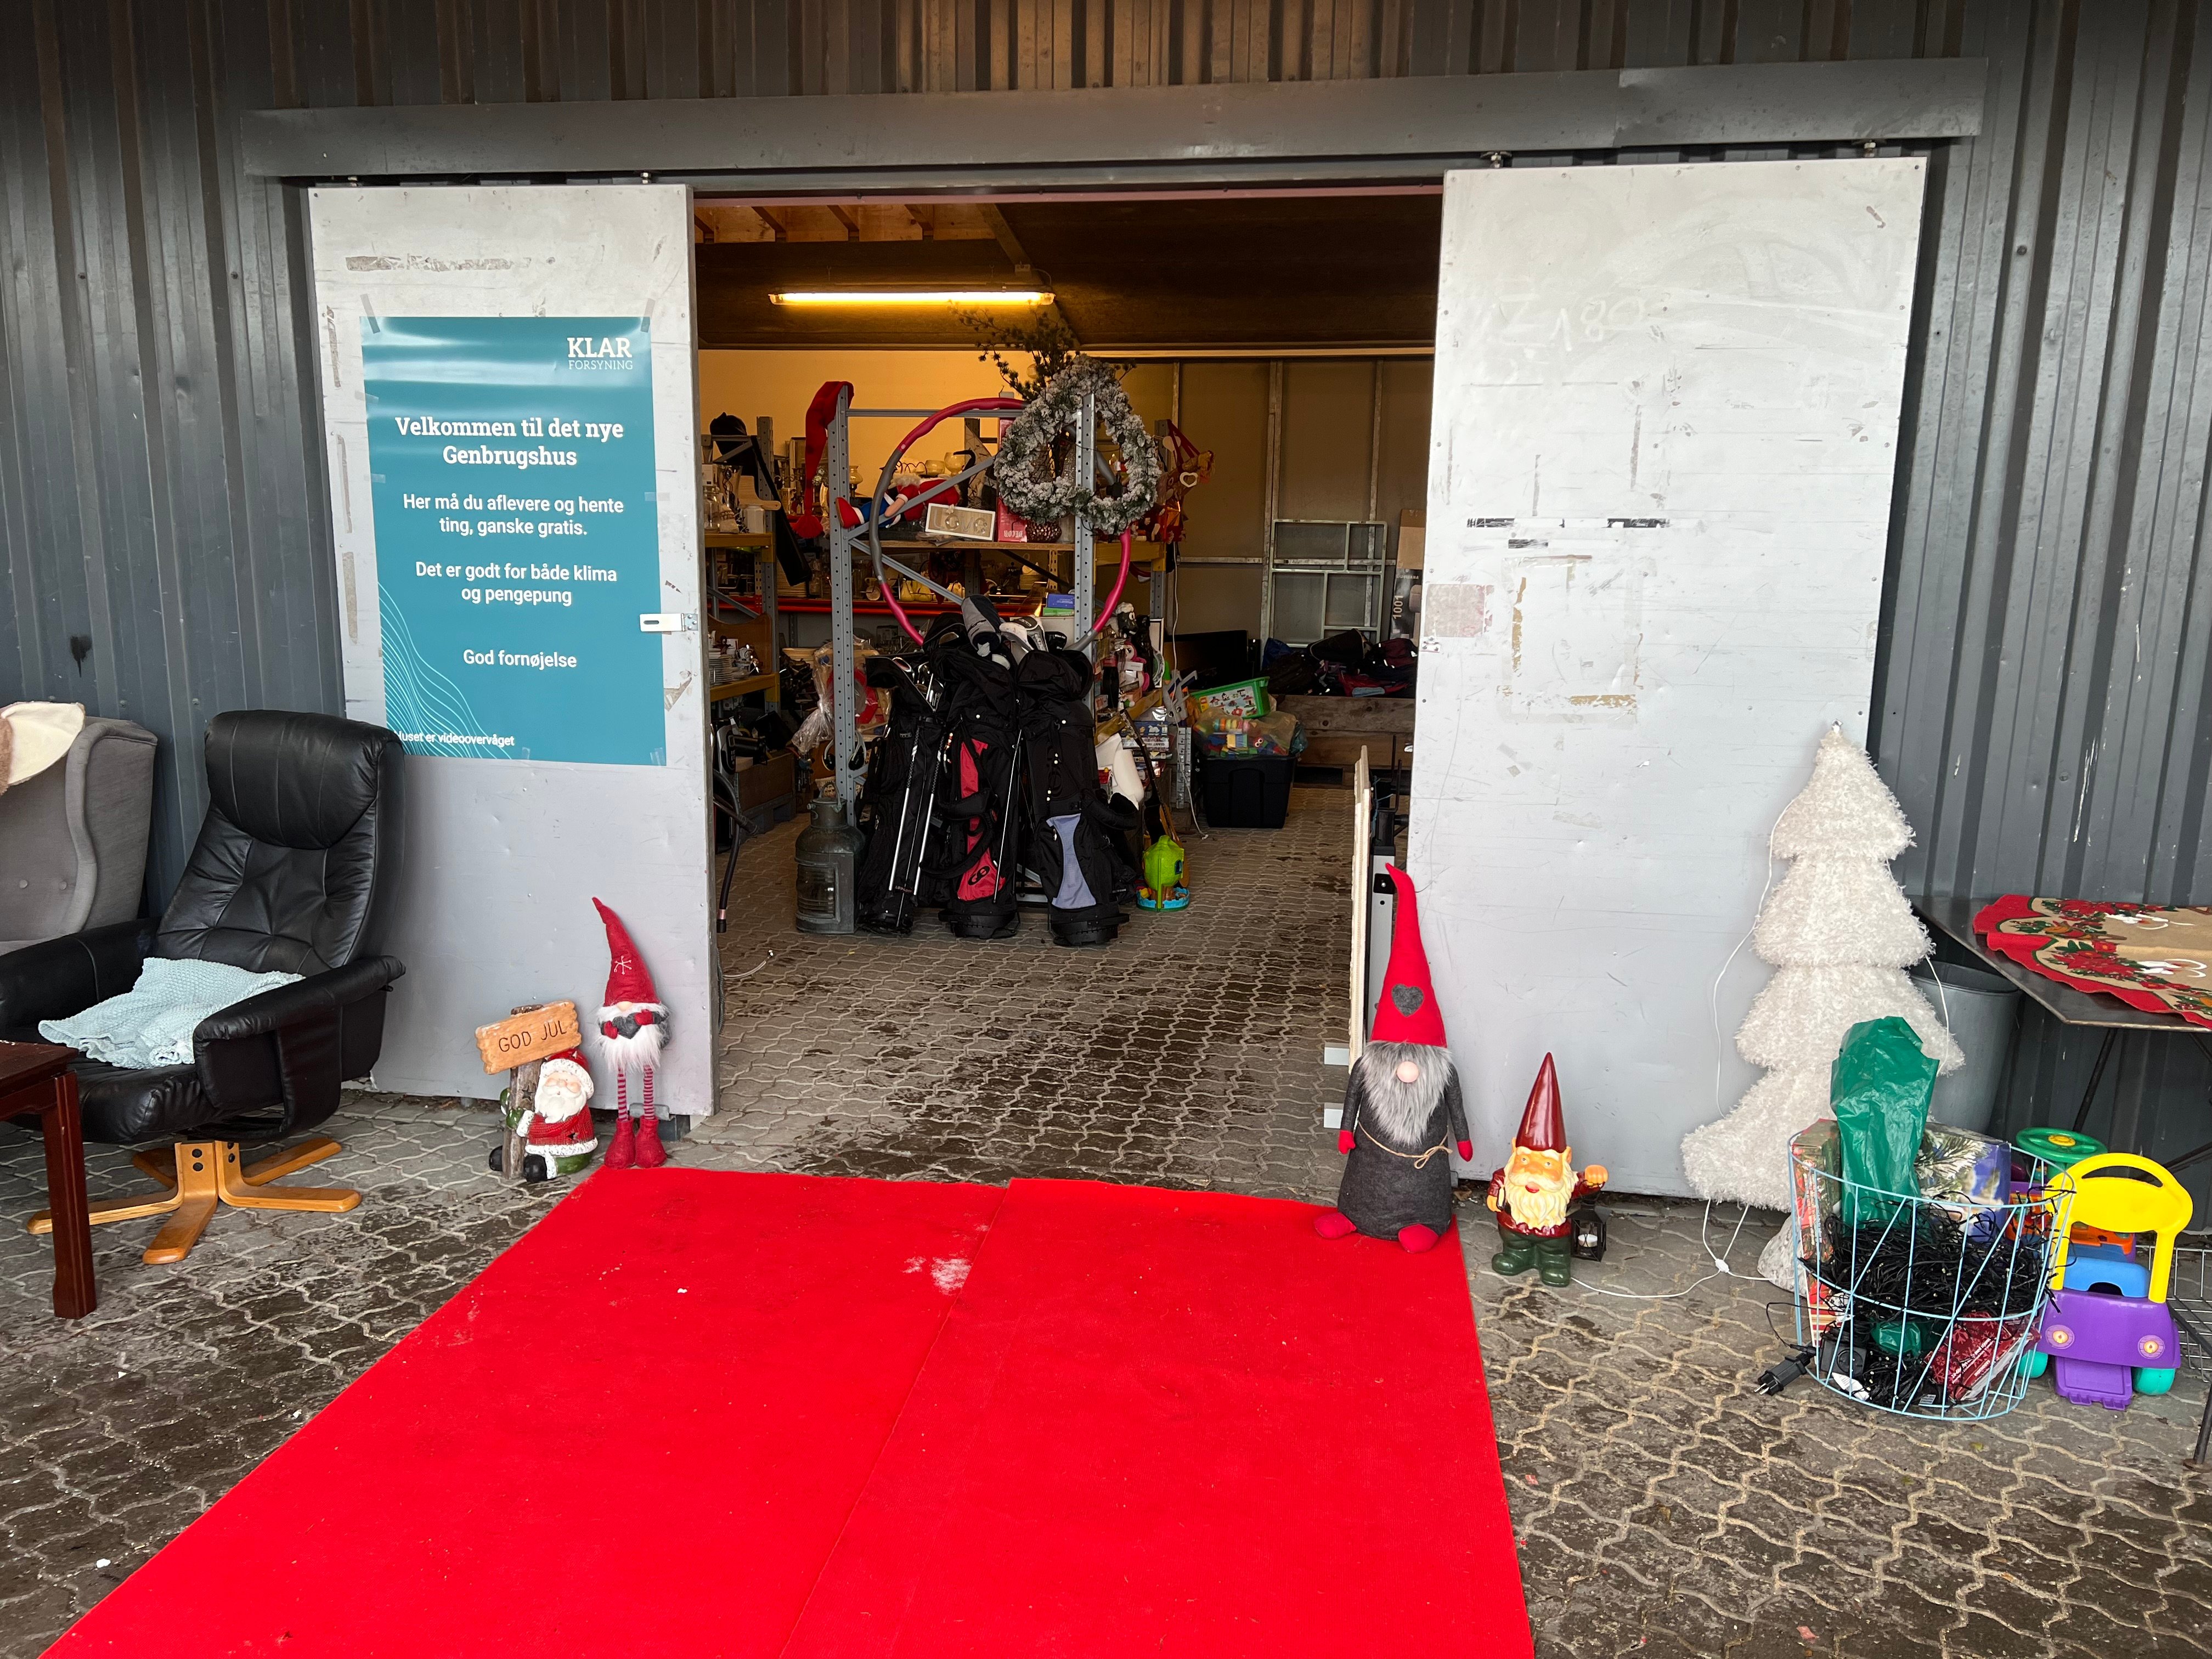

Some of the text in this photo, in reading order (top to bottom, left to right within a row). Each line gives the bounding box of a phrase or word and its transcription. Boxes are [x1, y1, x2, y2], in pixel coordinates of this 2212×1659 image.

[567, 337, 633, 358] KLAR
[569, 360, 633, 370] FORSYNING
[394, 416, 624, 443] Velkommen til det nye
[443, 445, 577, 470] Genbrugshus
[403, 493, 624, 516] Her må du aflevere og hente
[439, 517, 587, 538] ting, ganske gratis.
[416, 561, 617, 582] Det er godt for både klima
[461, 588, 572, 607] og pengepung
[1392, 595, 1404, 619] 1001
[463, 649, 577, 670] God fornøjelse
[426, 733, 436, 743] er
[439, 732, 515, 748] videoovervåget
[498, 1020, 567, 1053] GOD JUL
